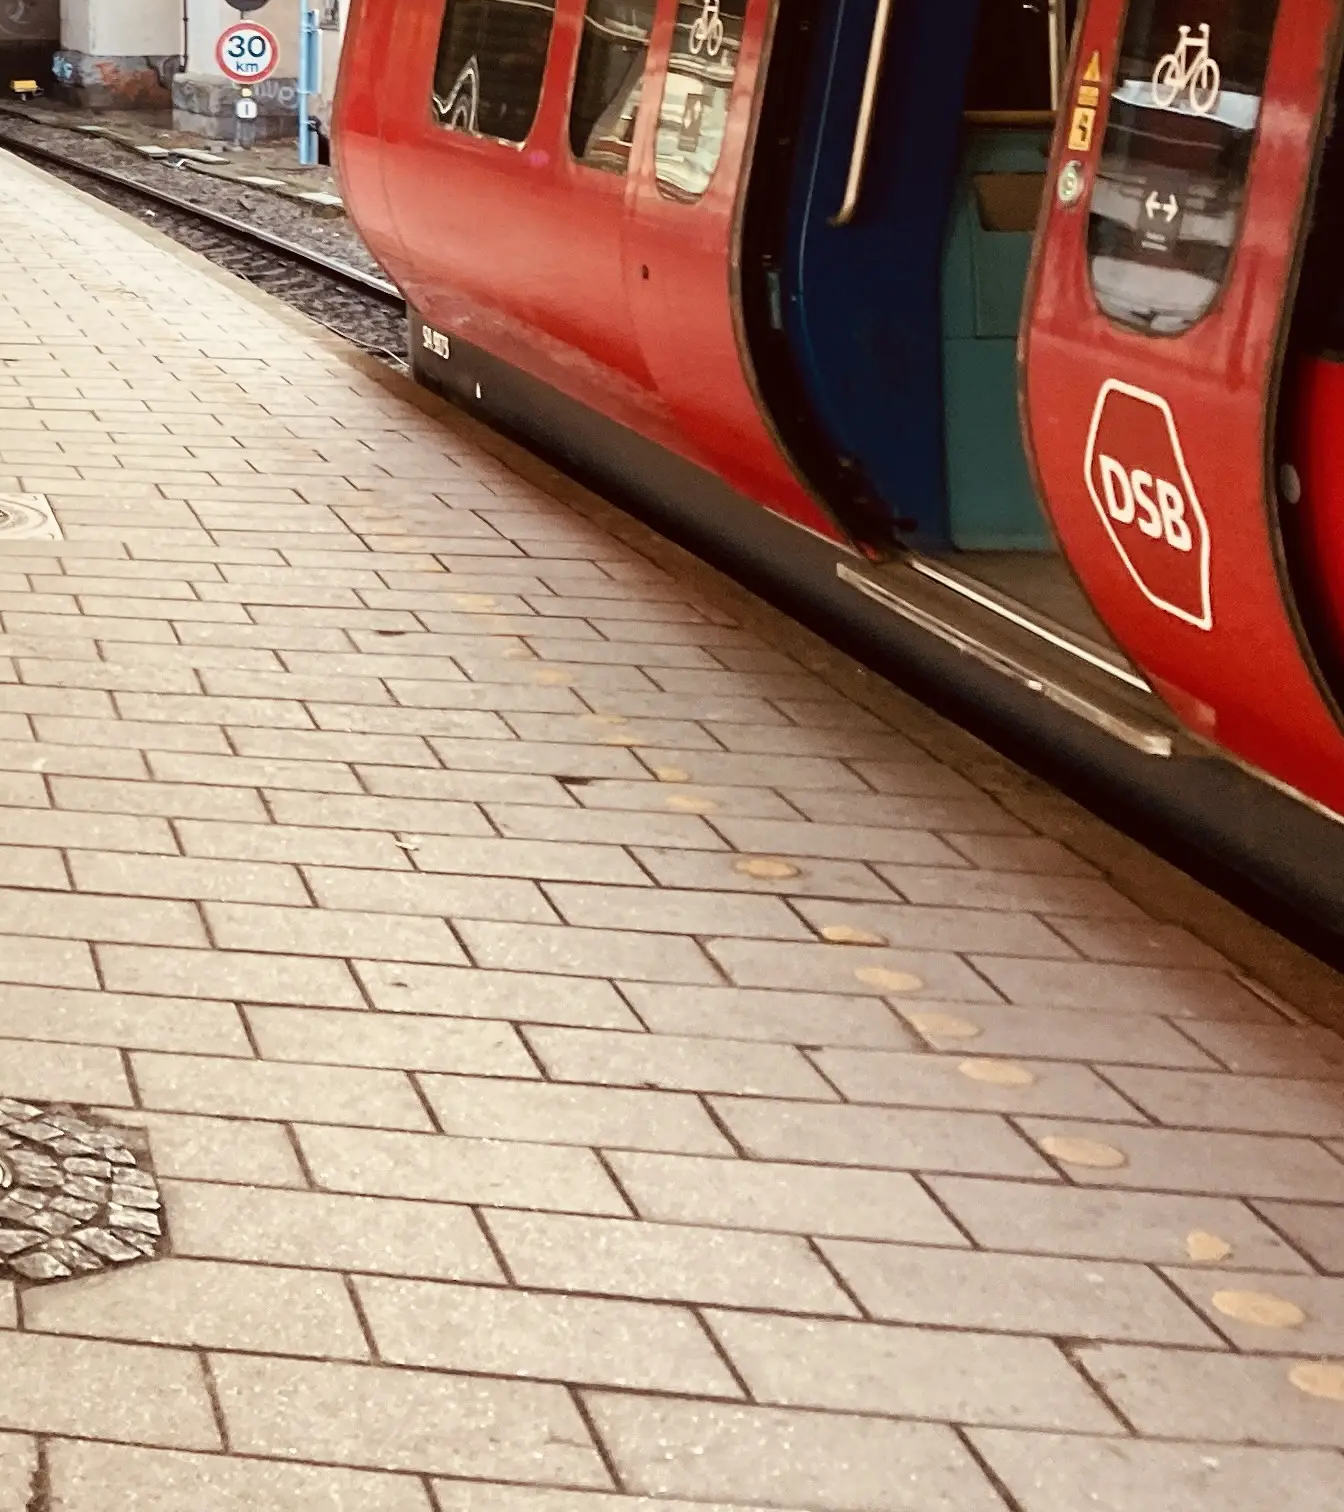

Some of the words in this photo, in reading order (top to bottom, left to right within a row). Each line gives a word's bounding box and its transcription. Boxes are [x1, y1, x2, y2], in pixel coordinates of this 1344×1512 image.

[227, 35, 266, 59] 30
[235, 60, 259, 73] km
[1098, 453, 1193, 552] DSB
